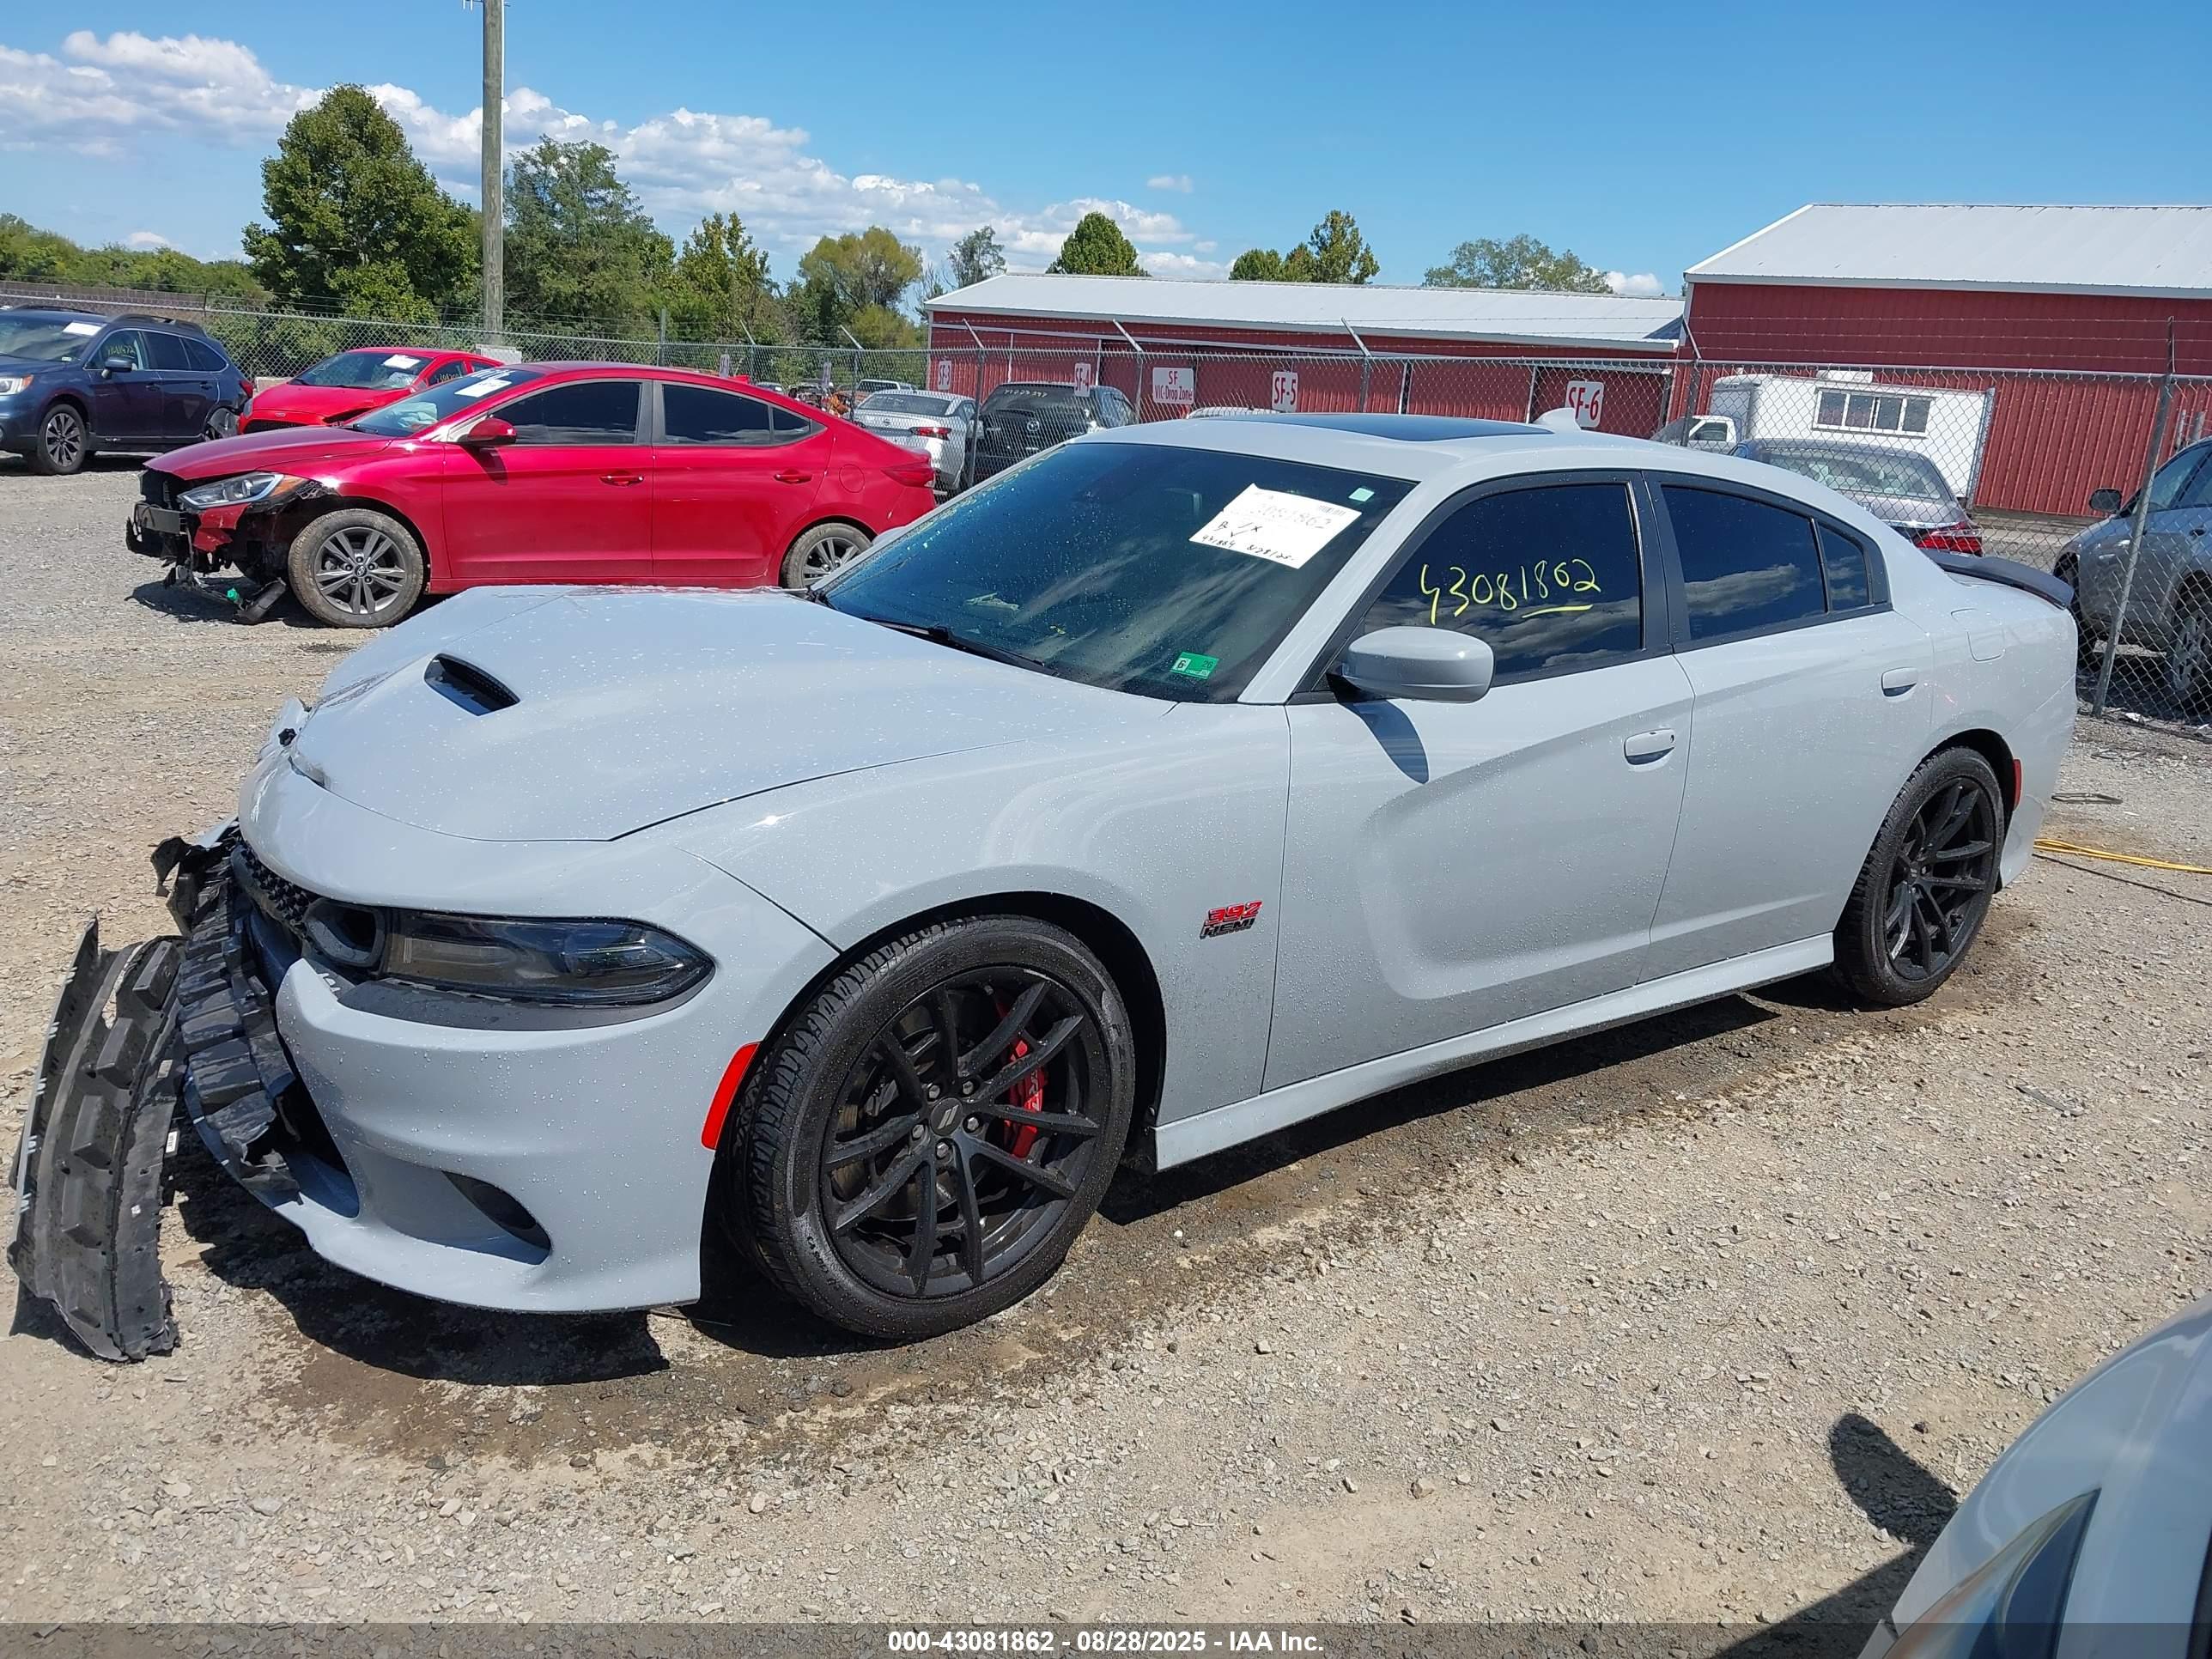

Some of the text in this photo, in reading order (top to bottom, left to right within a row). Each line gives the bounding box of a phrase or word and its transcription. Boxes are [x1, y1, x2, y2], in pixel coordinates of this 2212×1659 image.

[939, 365, 951, 386] SF-3
[1075, 368, 1090, 392] SF-4
[1169, 371, 1178, 385] SF
[1179, 386, 1192, 400] Zone
[1273, 376, 1297, 405] SF-5
[1568, 386, 1601, 421] SF-6
[1419, 558, 1601, 626] 43081862
[1205, 899, 1263, 925] 392
[1199, 917, 1255, 939] HEMI
